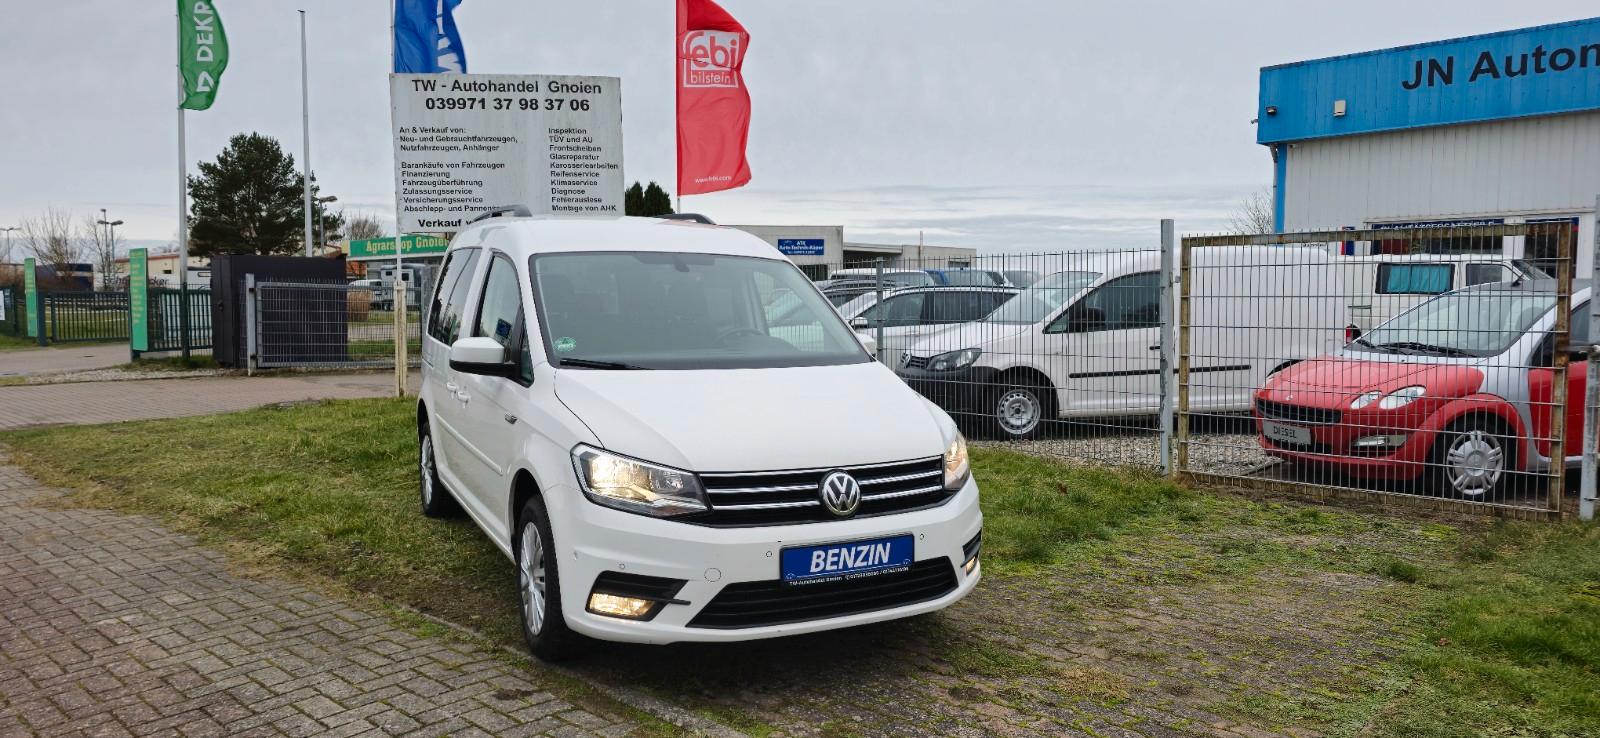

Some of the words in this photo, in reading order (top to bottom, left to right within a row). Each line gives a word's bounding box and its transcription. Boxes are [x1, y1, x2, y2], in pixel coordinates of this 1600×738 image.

[684, 30, 738, 69] febi
[690, 71, 731, 84] bilstein
[1402, 56, 1454, 90] JN
[412, 80, 437, 91] TW
[451, 80, 539, 93] Autohandel
[548, 80, 602, 94] Gnoien
[425, 98, 486, 110] 039971
[493, 98, 513, 110] 37
[518, 98, 539, 110] 98
[544, 98, 565, 111] 37
[569, 99, 590, 111] 06
[419, 126, 449, 134] Verkauf
[548, 127, 587, 136] Inspektion
[399, 135, 418, 143] Neu-
[419, 135, 434, 143] und
[548, 134, 565, 143] TÜV
[462, 144, 500, 152] Anhänger
[549, 144, 602, 152] Frontscheiben
[549, 153, 600, 162] Glasreparatur
[401, 161, 444, 169] Barankäufe
[461, 161, 505, 170] Fahrzeugen
[550, 162, 619, 170] Karosseriearbeiten
[401, 170, 451, 179] Finanzierung
[550, 170, 600, 178] Reifenservice
[402, 179, 483, 188] Fahrzeugüberführung
[402, 188, 473, 196] Zulassungsservice
[551, 187, 586, 195] Diagnose
[403, 196, 484, 205] Versicherungsservice
[404, 205, 447, 213] Abschlepp-
[551, 204, 583, 212] Montage
[418, 218, 462, 228] Verkauf
[366, 238, 413, 253] Agrarsop
[1273, 425, 1297, 439] DIESEL
[810, 542, 891, 573] BENZIN
